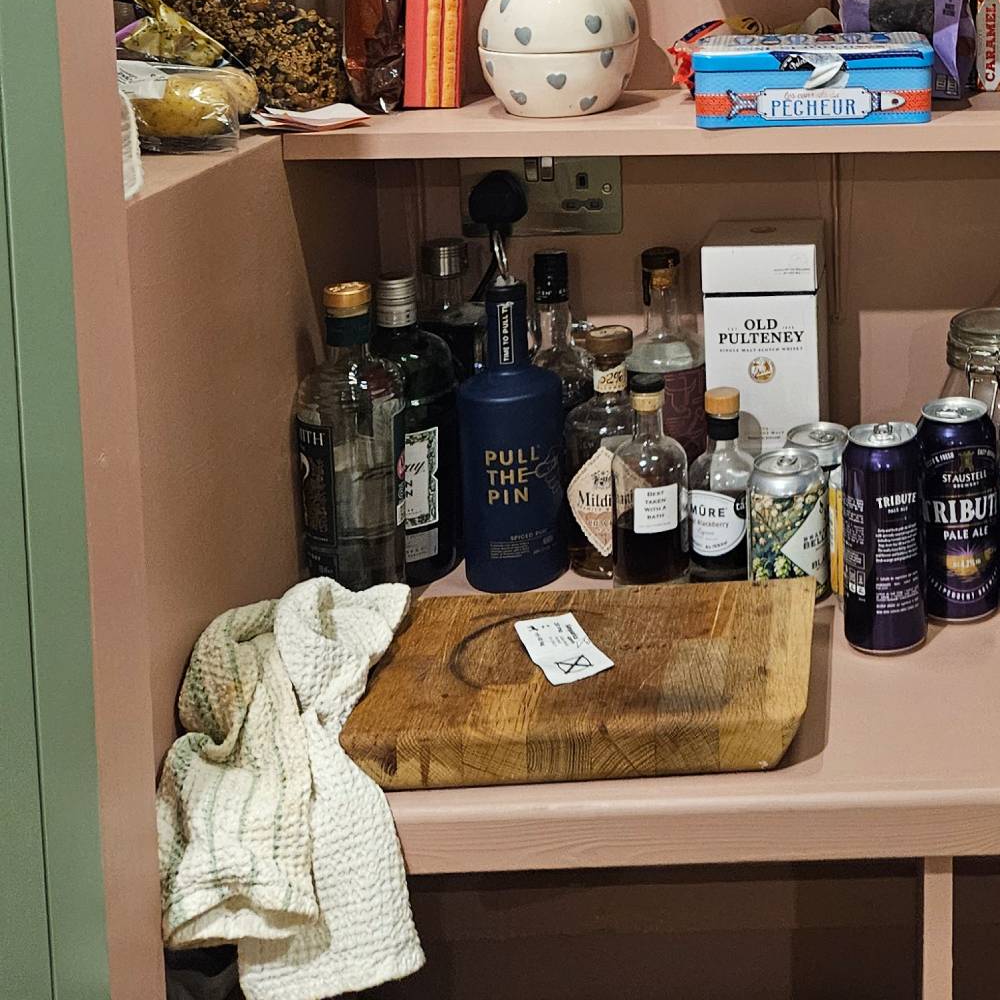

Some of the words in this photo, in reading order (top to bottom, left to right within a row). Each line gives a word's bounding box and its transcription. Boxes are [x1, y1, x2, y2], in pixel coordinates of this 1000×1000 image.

[985, 4, 997, 82] CARAMEL
[744, 318, 778, 330] OLD
[502, 335, 509, 345] TO
[718, 330, 804, 344] PULTENEY
[485, 446, 540, 467] PULL
[487, 467, 529, 486] THE
[953, 481, 980, 489] BREWERY
[488, 487, 529, 505] PIN
[876, 492, 917, 509] TRIBUTE
[922, 492, 998, 524] TRIBUT
[943, 529, 969, 541] PALE
[972, 525, 989, 538] ALE
